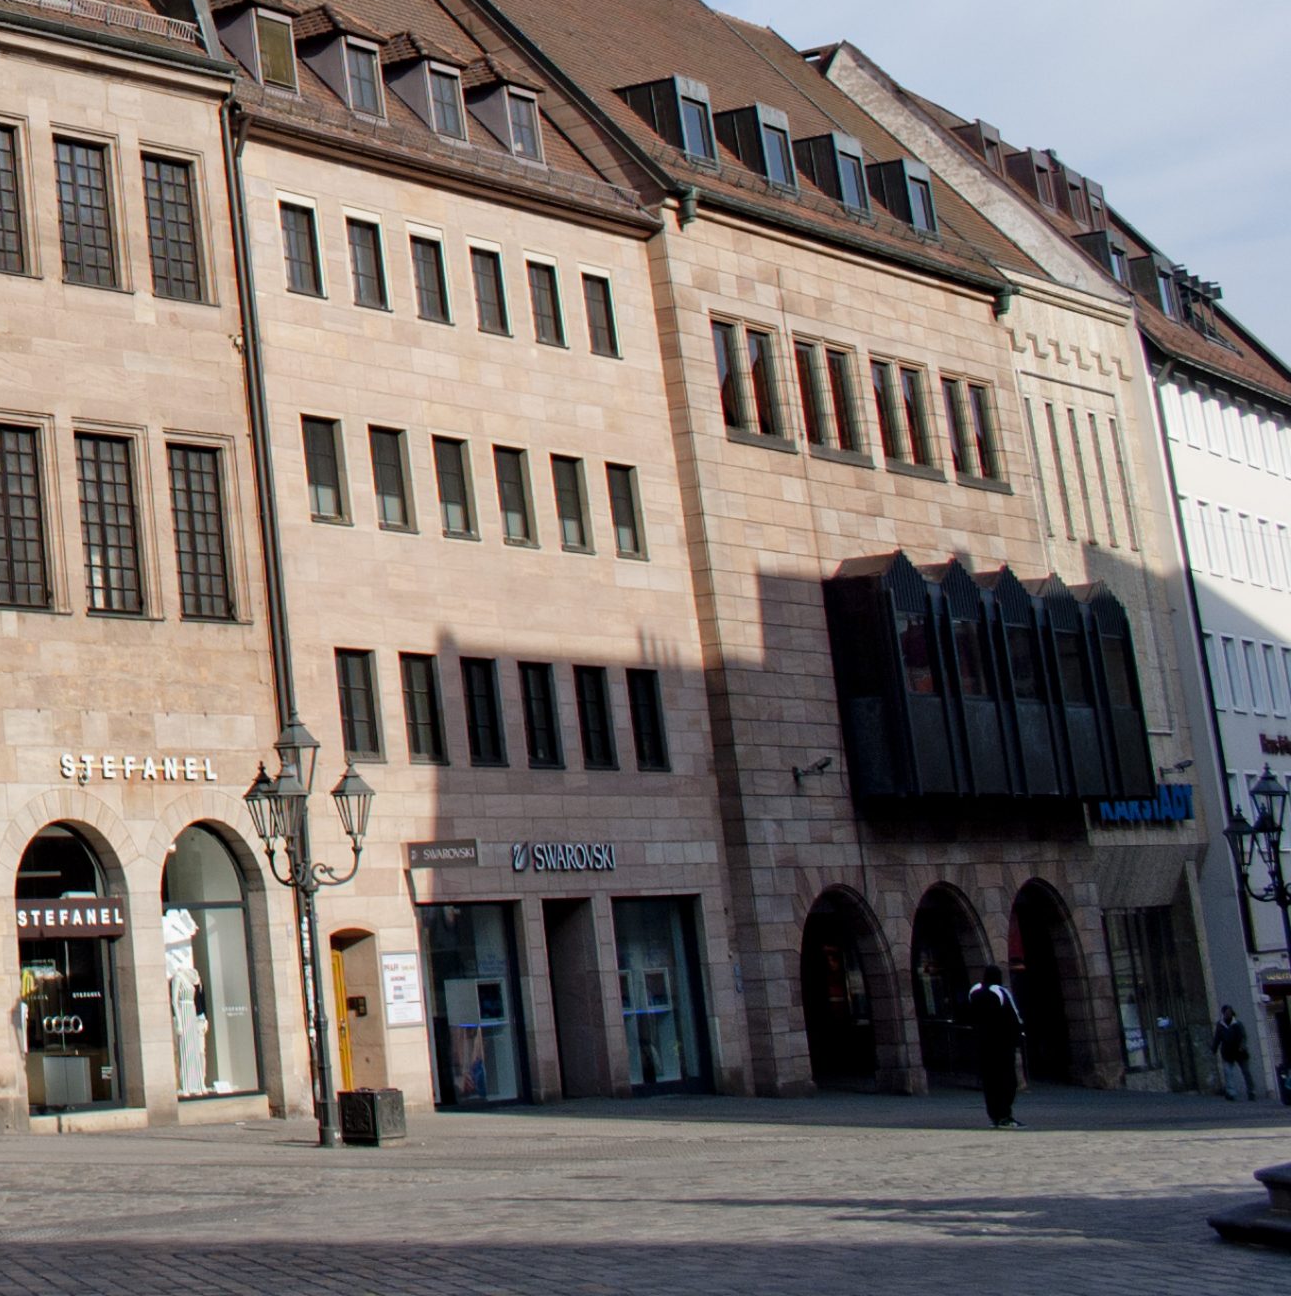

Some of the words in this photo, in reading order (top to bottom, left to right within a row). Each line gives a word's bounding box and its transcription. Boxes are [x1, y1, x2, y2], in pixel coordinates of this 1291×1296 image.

[60, 752, 218, 781] STEFANEL
[422, 847, 475, 861] SWAROVSKI
[533, 843, 616, 871] SWAROVSKI
[17, 907, 124, 927] STEFANEL
